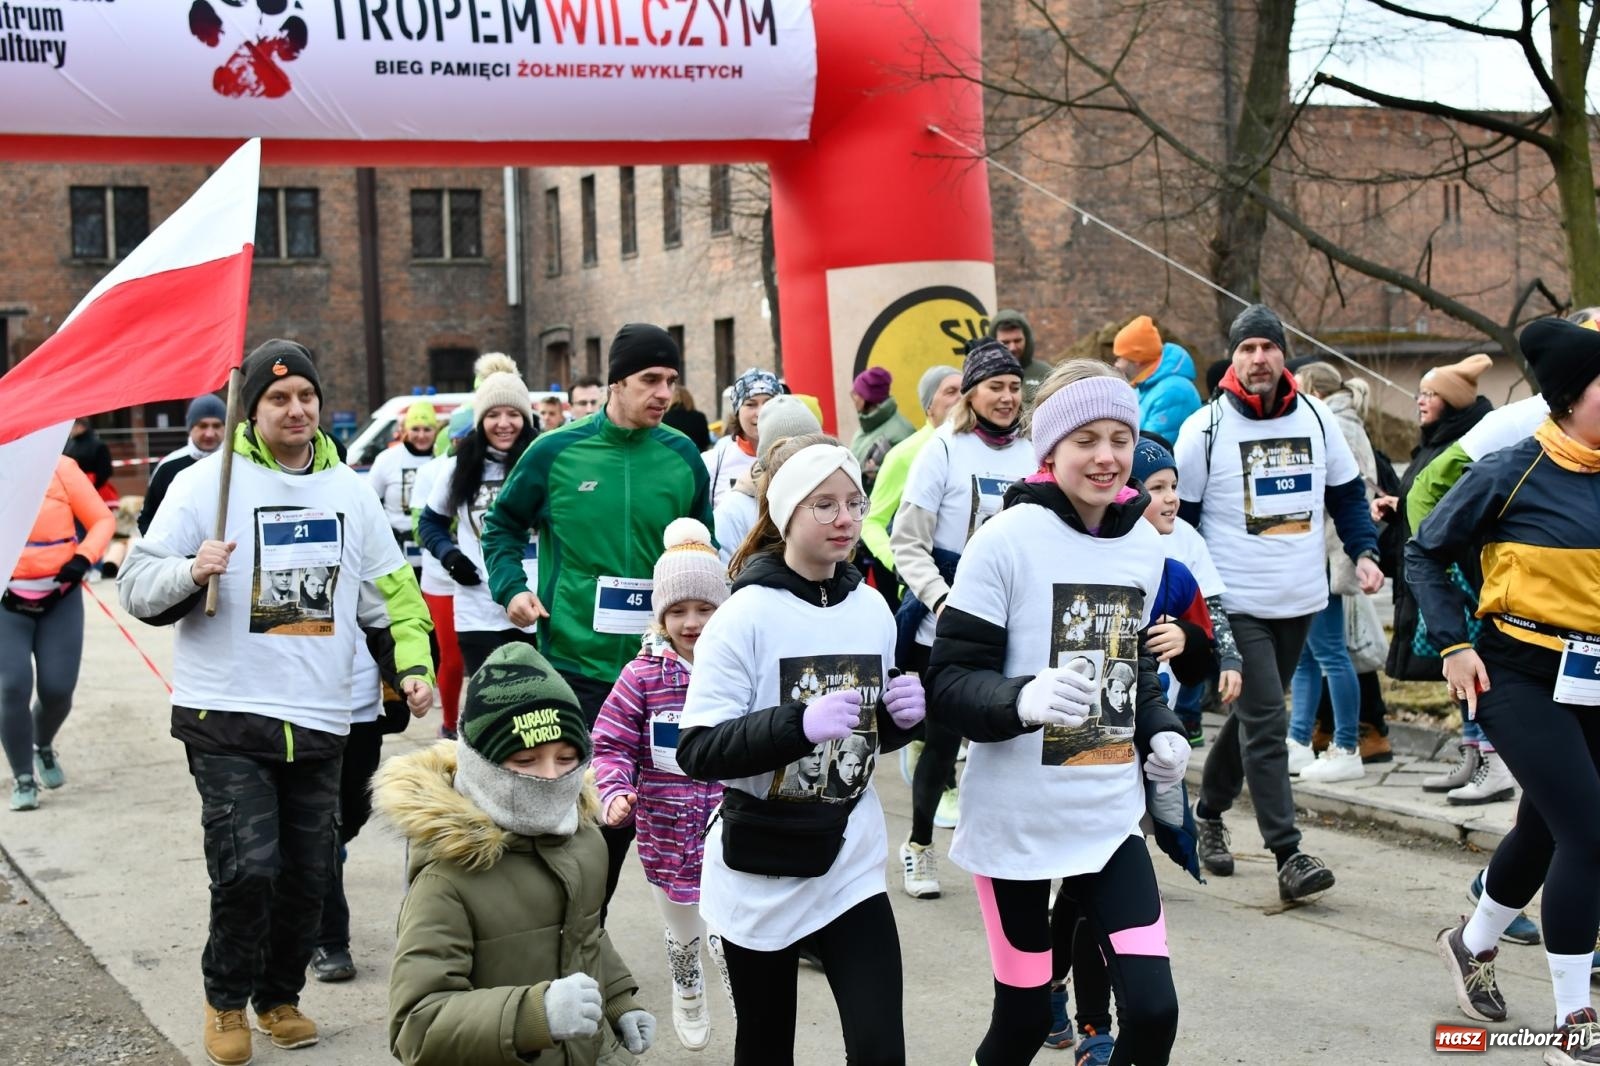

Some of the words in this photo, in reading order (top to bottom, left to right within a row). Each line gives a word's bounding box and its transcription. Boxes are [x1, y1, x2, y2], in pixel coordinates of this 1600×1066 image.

[375, 60, 423, 75] BIEG
[430, 61, 510, 80] PAMIĘCI
[517, 59, 625, 78] ŻOŁNIERZY
[631, 65, 743, 82] WYKLĘTYCH
[1275, 478, 1295, 490] 103
[294, 524, 309, 538] 21
[626, 593, 643, 606] 45
[512, 708, 561, 735] JURASSIC
[520, 725, 562, 748] WORLD
